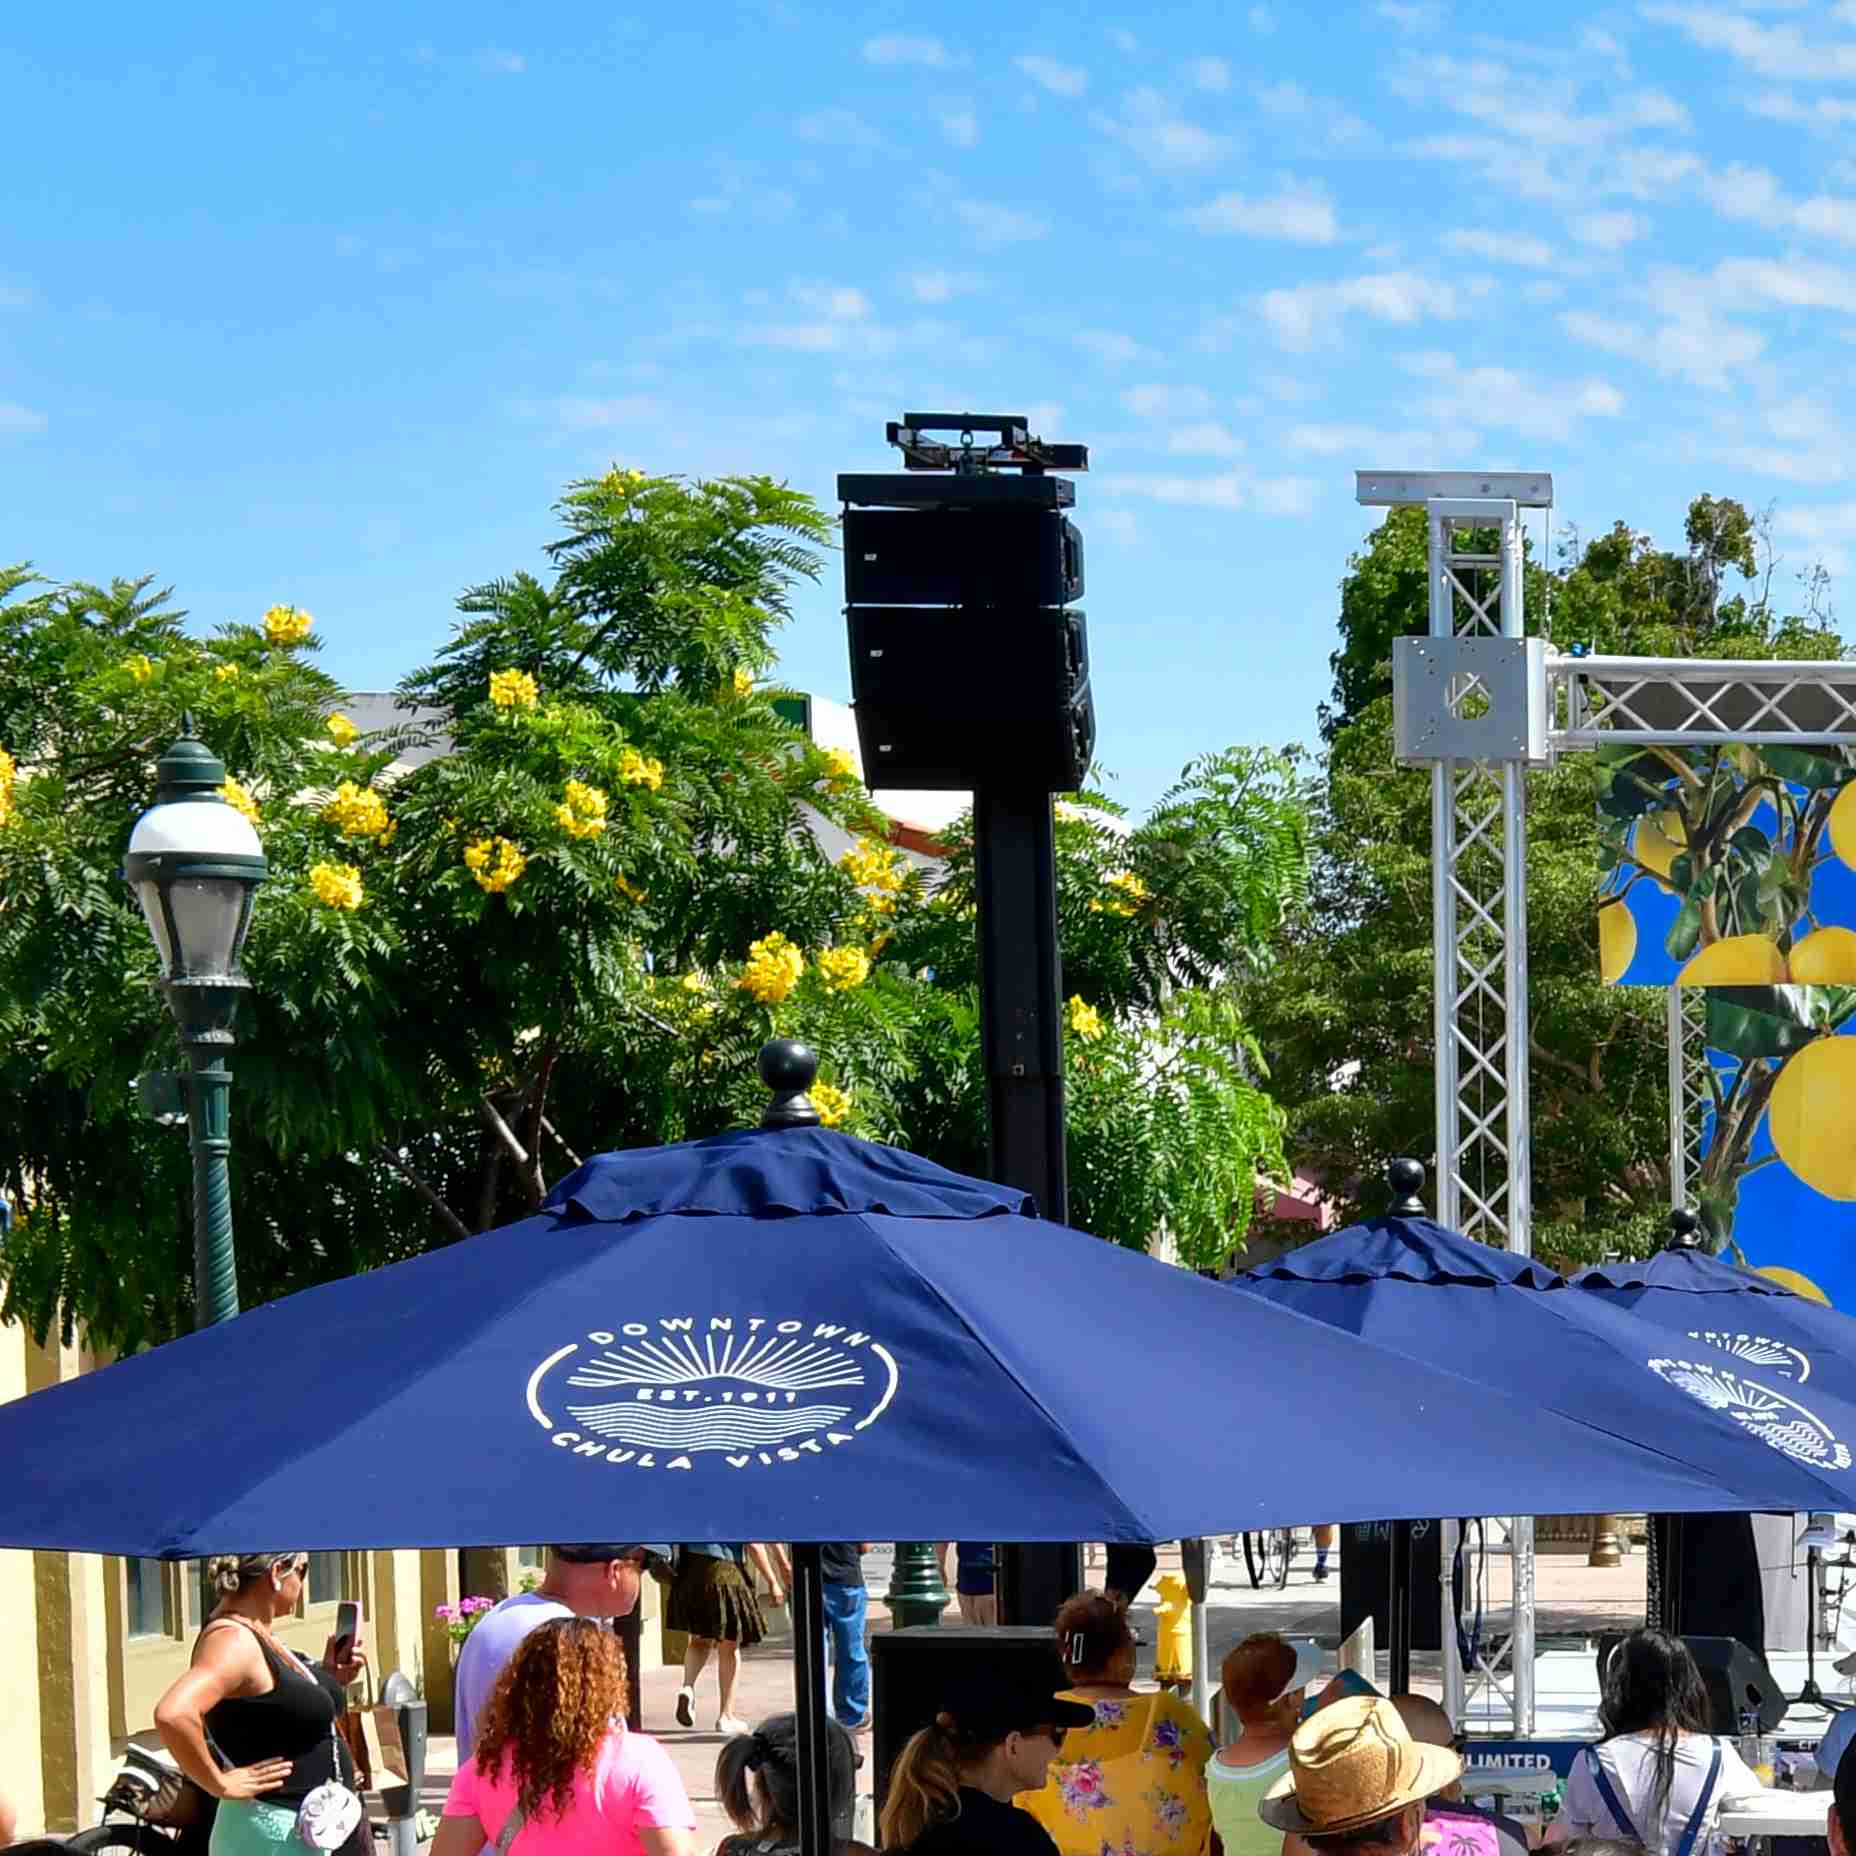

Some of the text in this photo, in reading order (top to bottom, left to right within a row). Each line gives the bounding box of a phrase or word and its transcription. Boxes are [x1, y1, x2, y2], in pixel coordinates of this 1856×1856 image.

[588, 1316, 871, 1347] DOWNTOWN
[550, 1430, 855, 1471] CHULA VISTA
